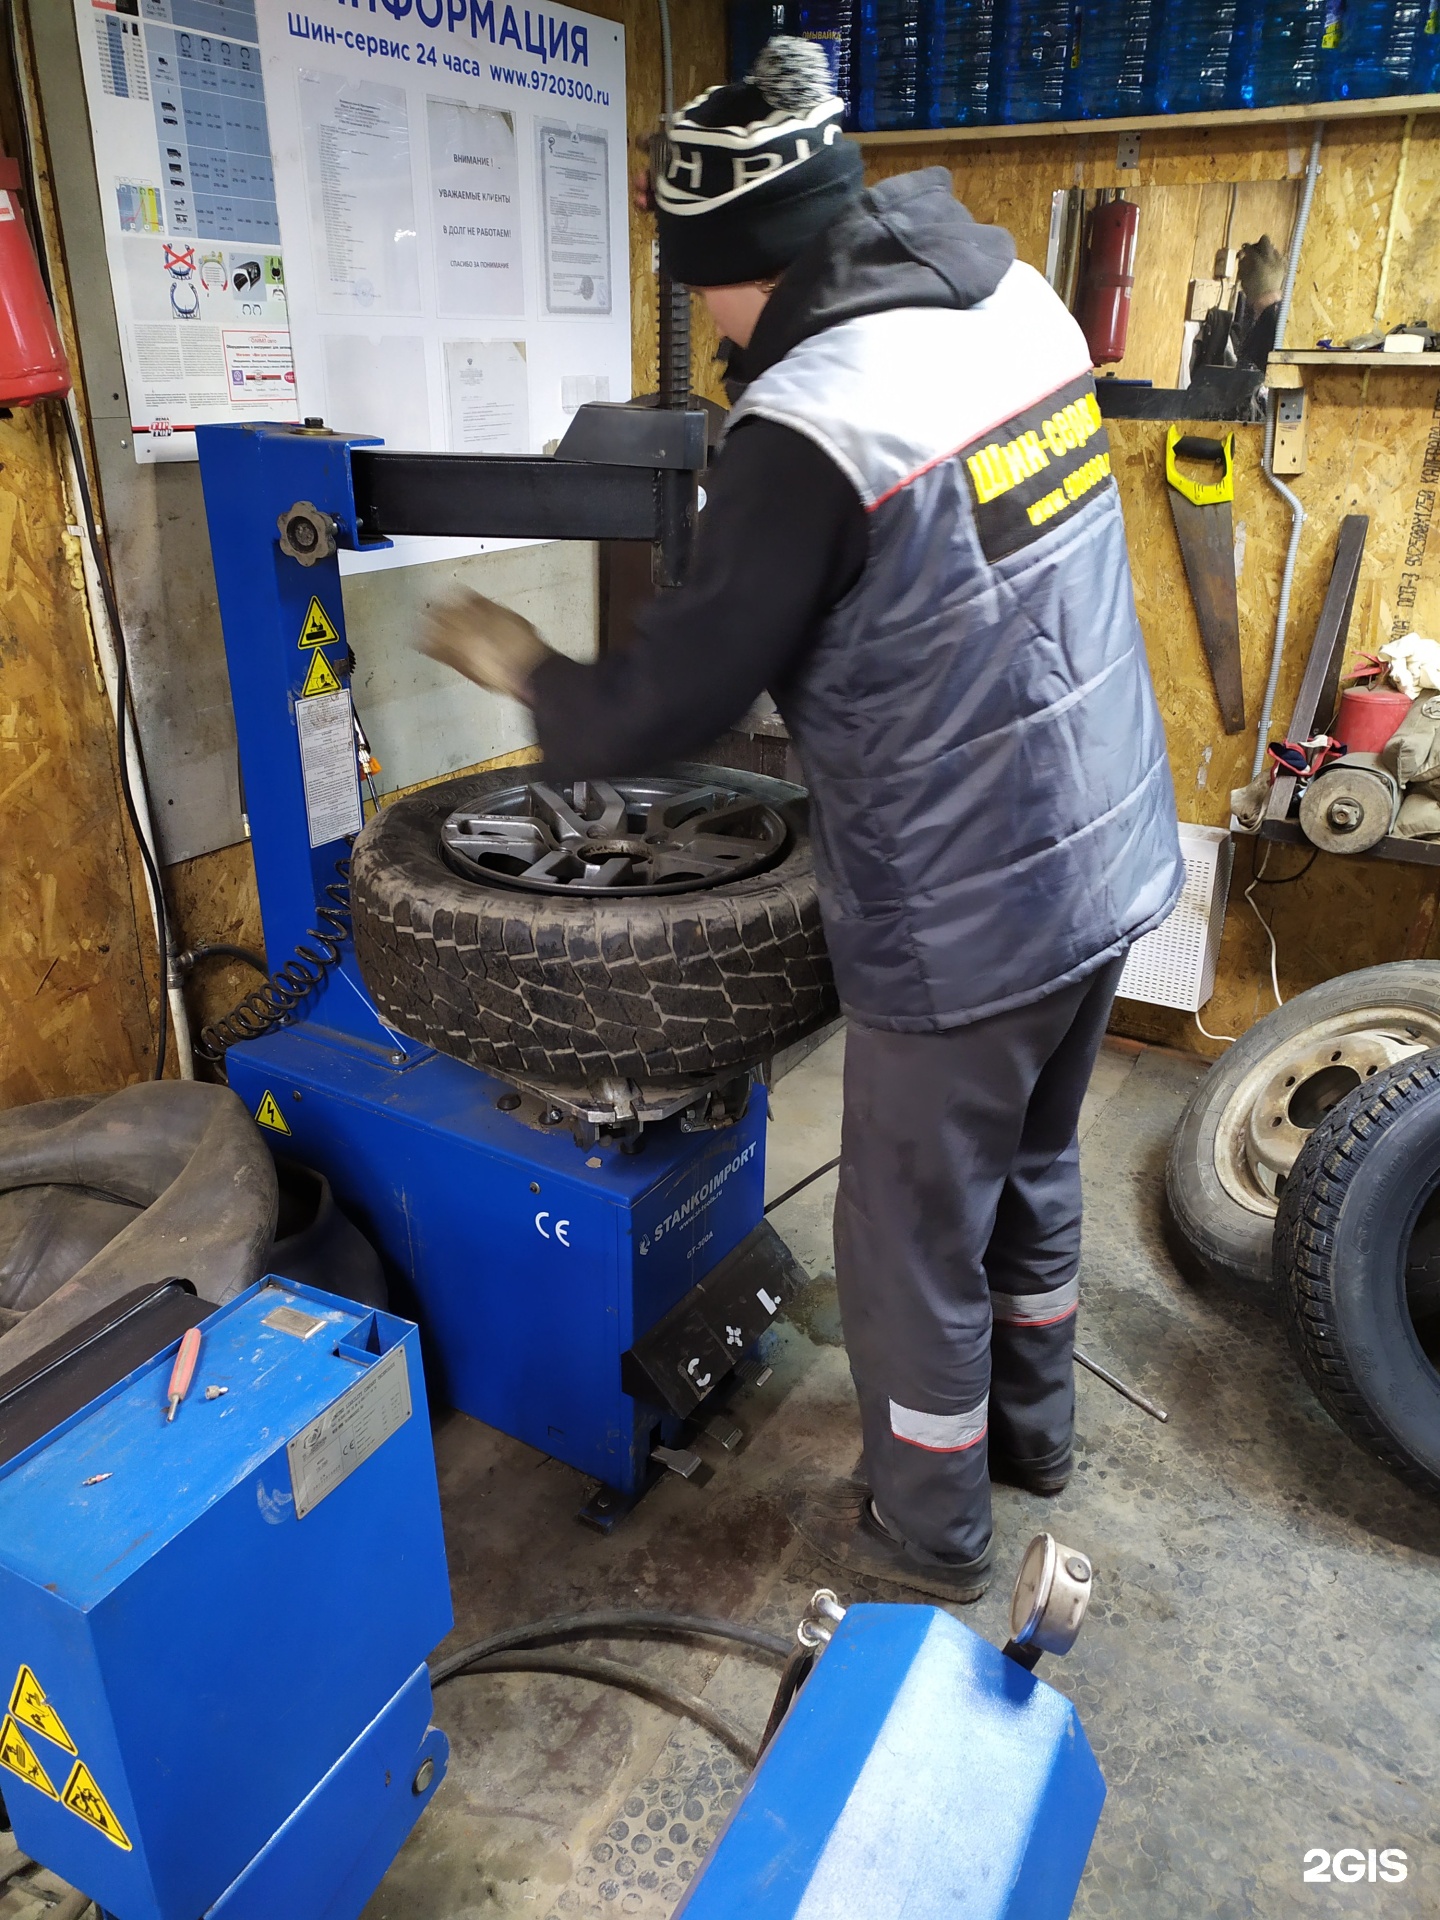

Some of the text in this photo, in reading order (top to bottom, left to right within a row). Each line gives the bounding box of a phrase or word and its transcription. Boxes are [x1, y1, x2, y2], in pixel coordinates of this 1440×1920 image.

[287, 12, 611, 107] Шин-сервис 24 часа www.9720300.ru
[453, 153, 490, 167] ВНИМАНИЕ
[438, 188, 511, 203] УВАЖАЕМЫЕ КЛИЕНТЫ
[443, 224, 512, 238] В ДОЛГ НЕ РАБОТАЕМ!
[450, 260, 473, 268] СПАСИБО
[480, 261, 509, 269] ПОНИМАНИЕ
[653, 1140, 757, 1242] STANKOIMPORT
[534, 1211, 570, 1248] CE
